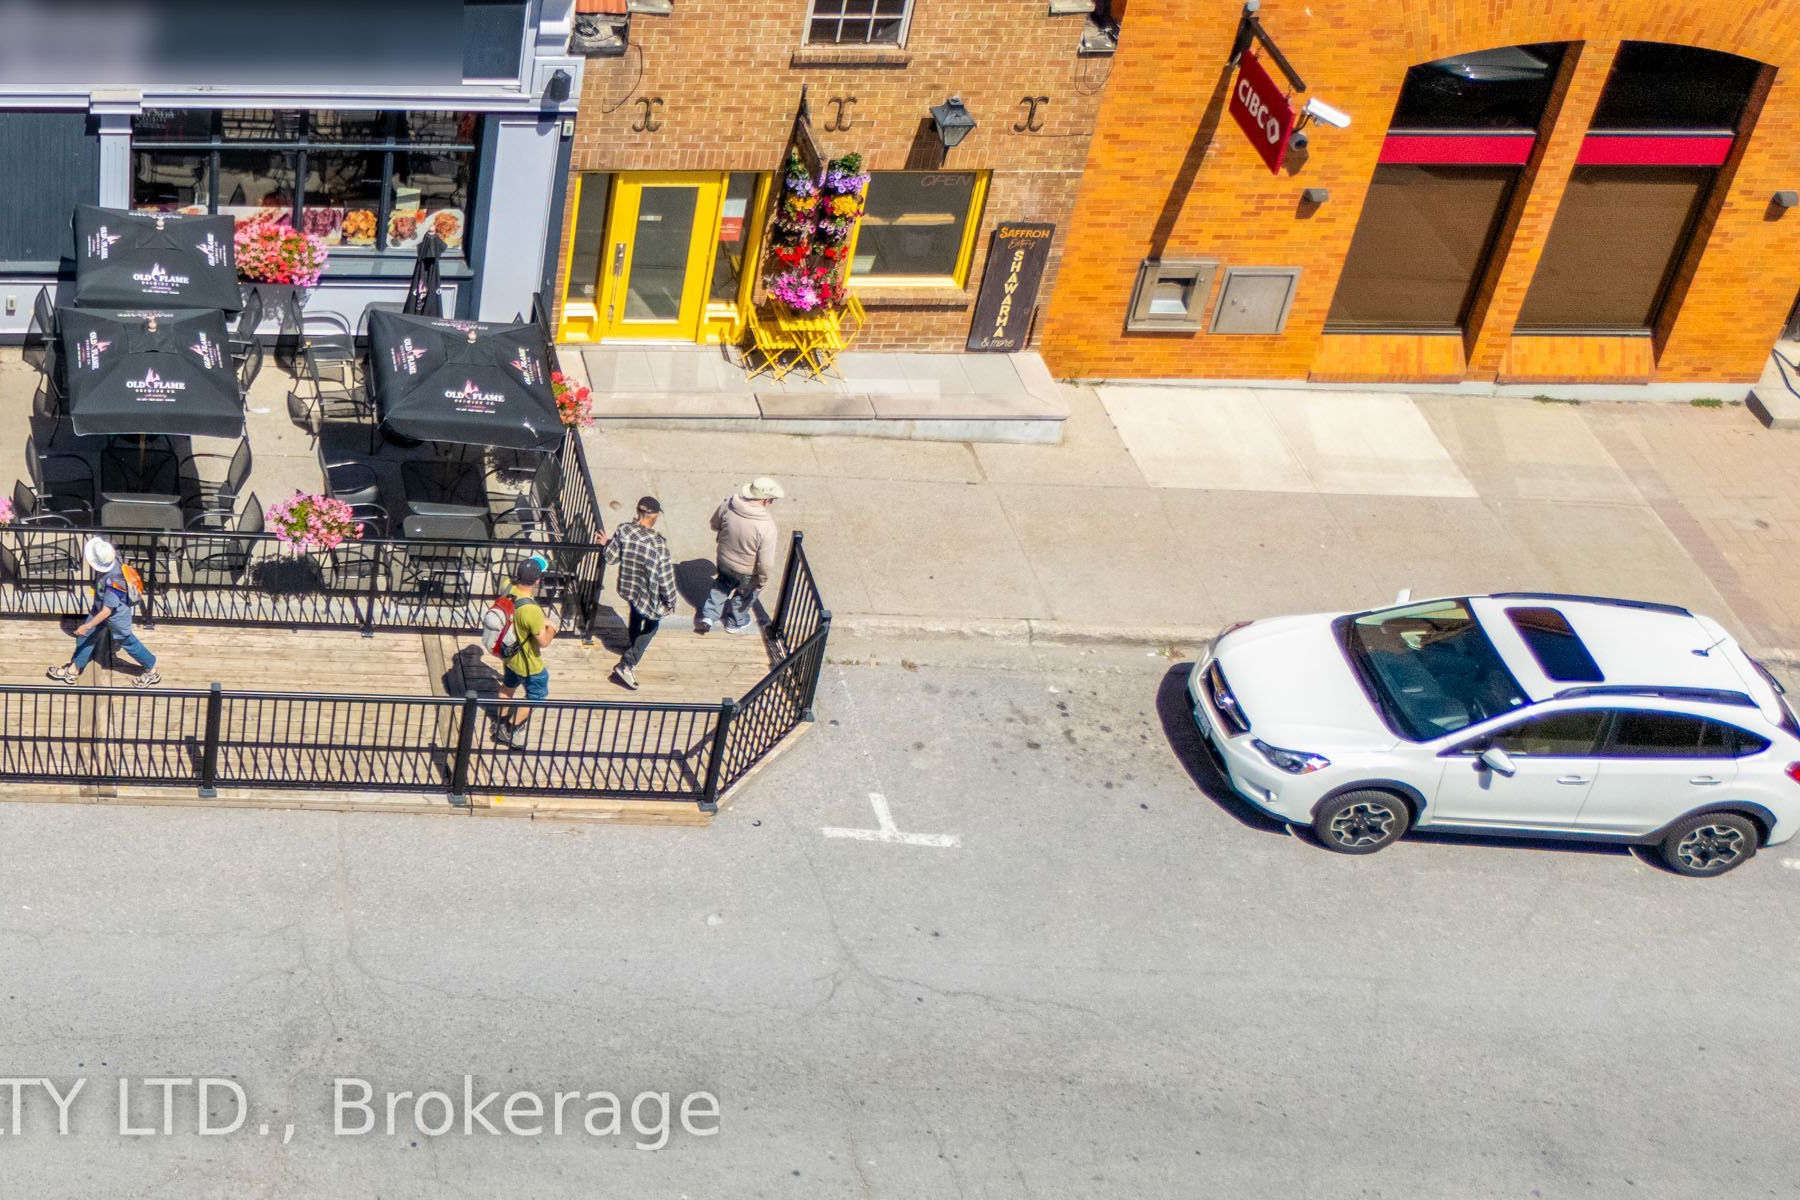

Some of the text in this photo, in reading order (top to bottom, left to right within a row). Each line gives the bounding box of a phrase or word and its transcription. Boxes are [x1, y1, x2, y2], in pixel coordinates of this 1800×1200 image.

[1238, 79, 1269, 130] CIBC
[999, 226, 1051, 239] SAFFRON
[993, 250, 1025, 338] SHAWARMA
[989, 337, 1015, 348] more
[126, 380, 186, 390] OLD FLAME
[444, 390, 505, 403] OLD FLAME
